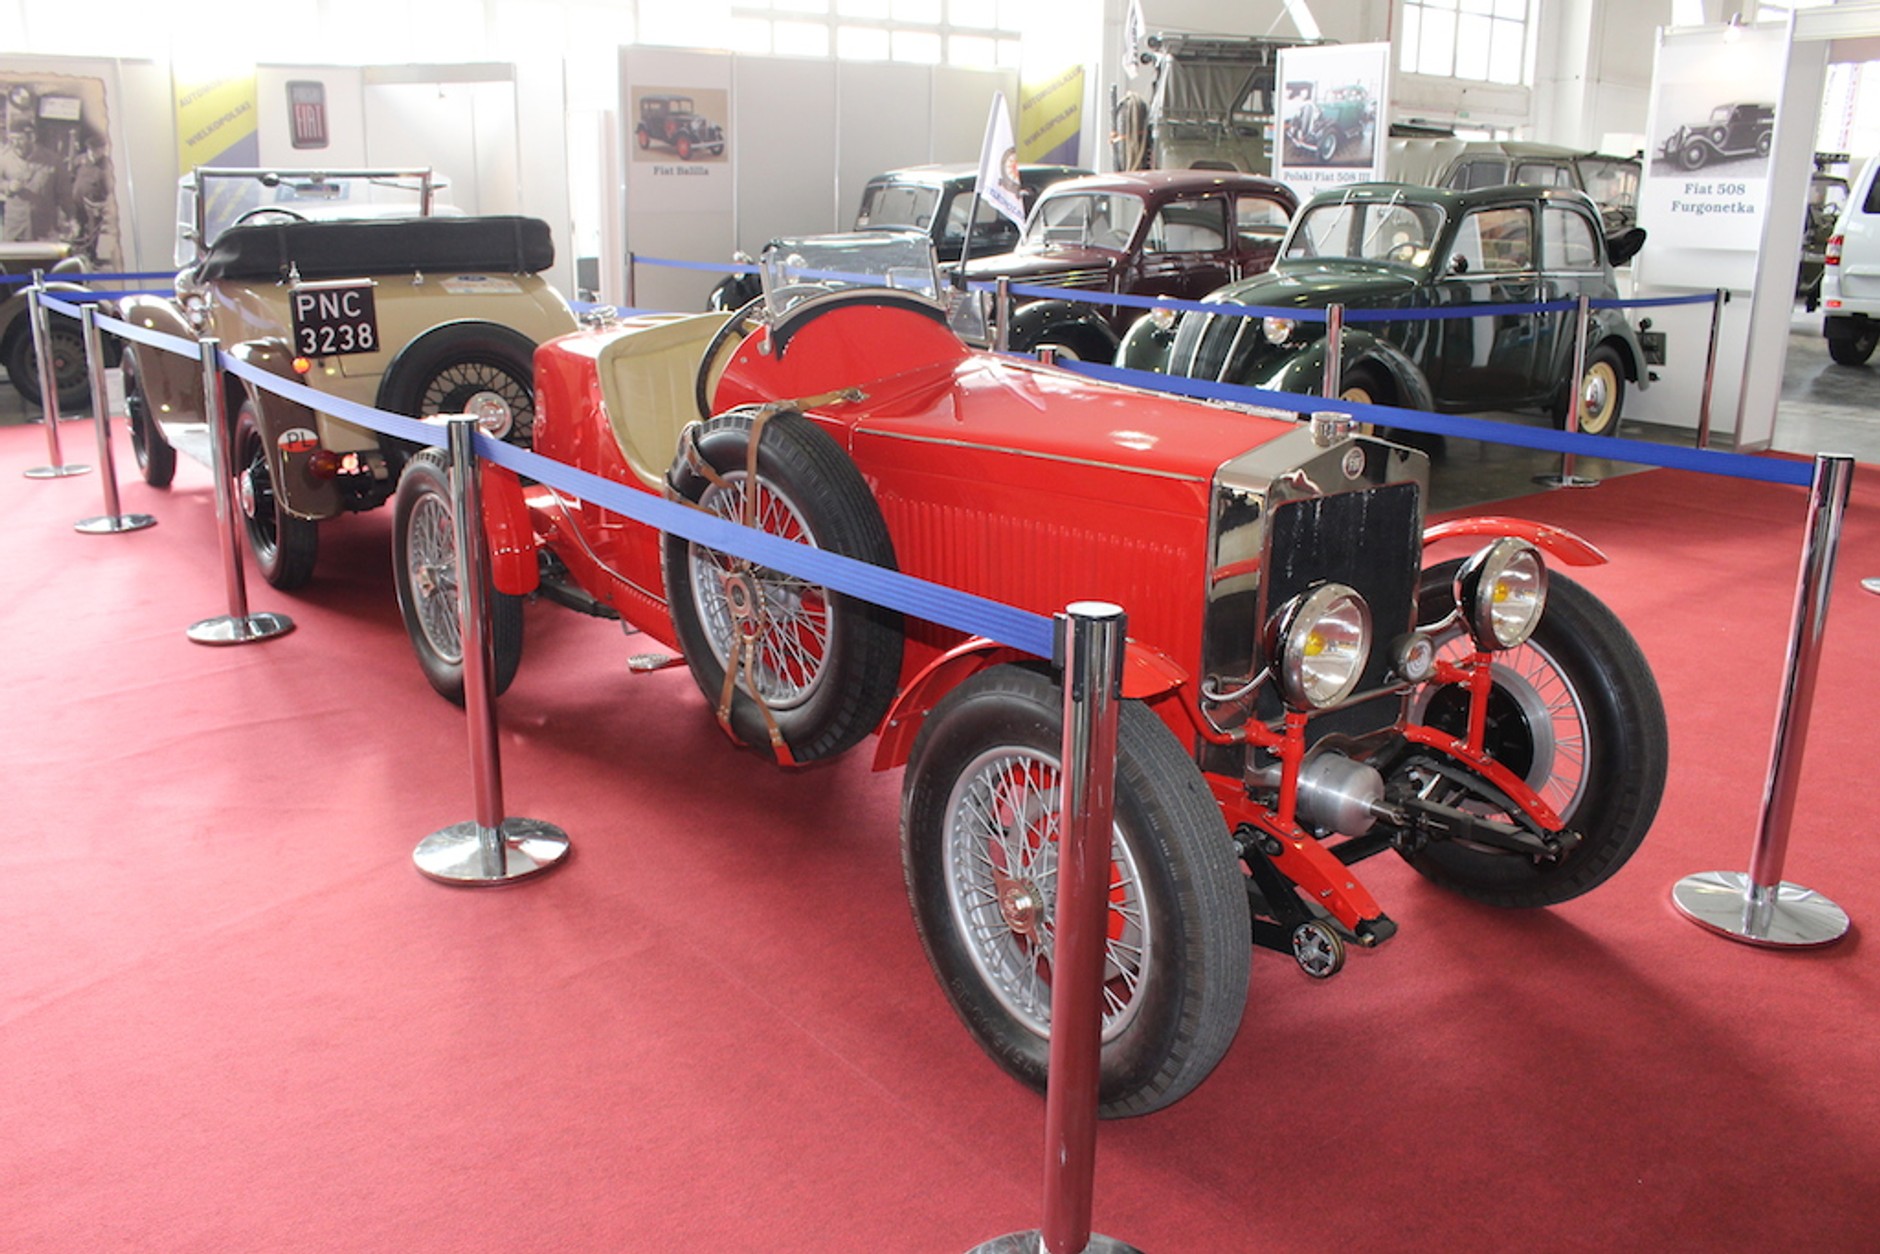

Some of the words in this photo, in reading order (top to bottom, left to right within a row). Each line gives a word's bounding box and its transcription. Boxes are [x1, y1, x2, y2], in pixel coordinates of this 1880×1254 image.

[295, 103, 323, 139] FIAT
[653, 165, 674, 176] Fiat
[676, 165, 709, 176] Balilla
[1283, 170, 1312, 181] Polski
[1315, 170, 1335, 181] Fiat
[1337, 170, 1356, 182] 508
[1684, 183, 1713, 195] Fiat
[1717, 183, 1746, 195] 508
[1671, 200, 1755, 215] Furgonetka
[296, 290, 361, 322] PNC
[301, 322, 374, 354] 3238
[287, 431, 312, 449] PL
